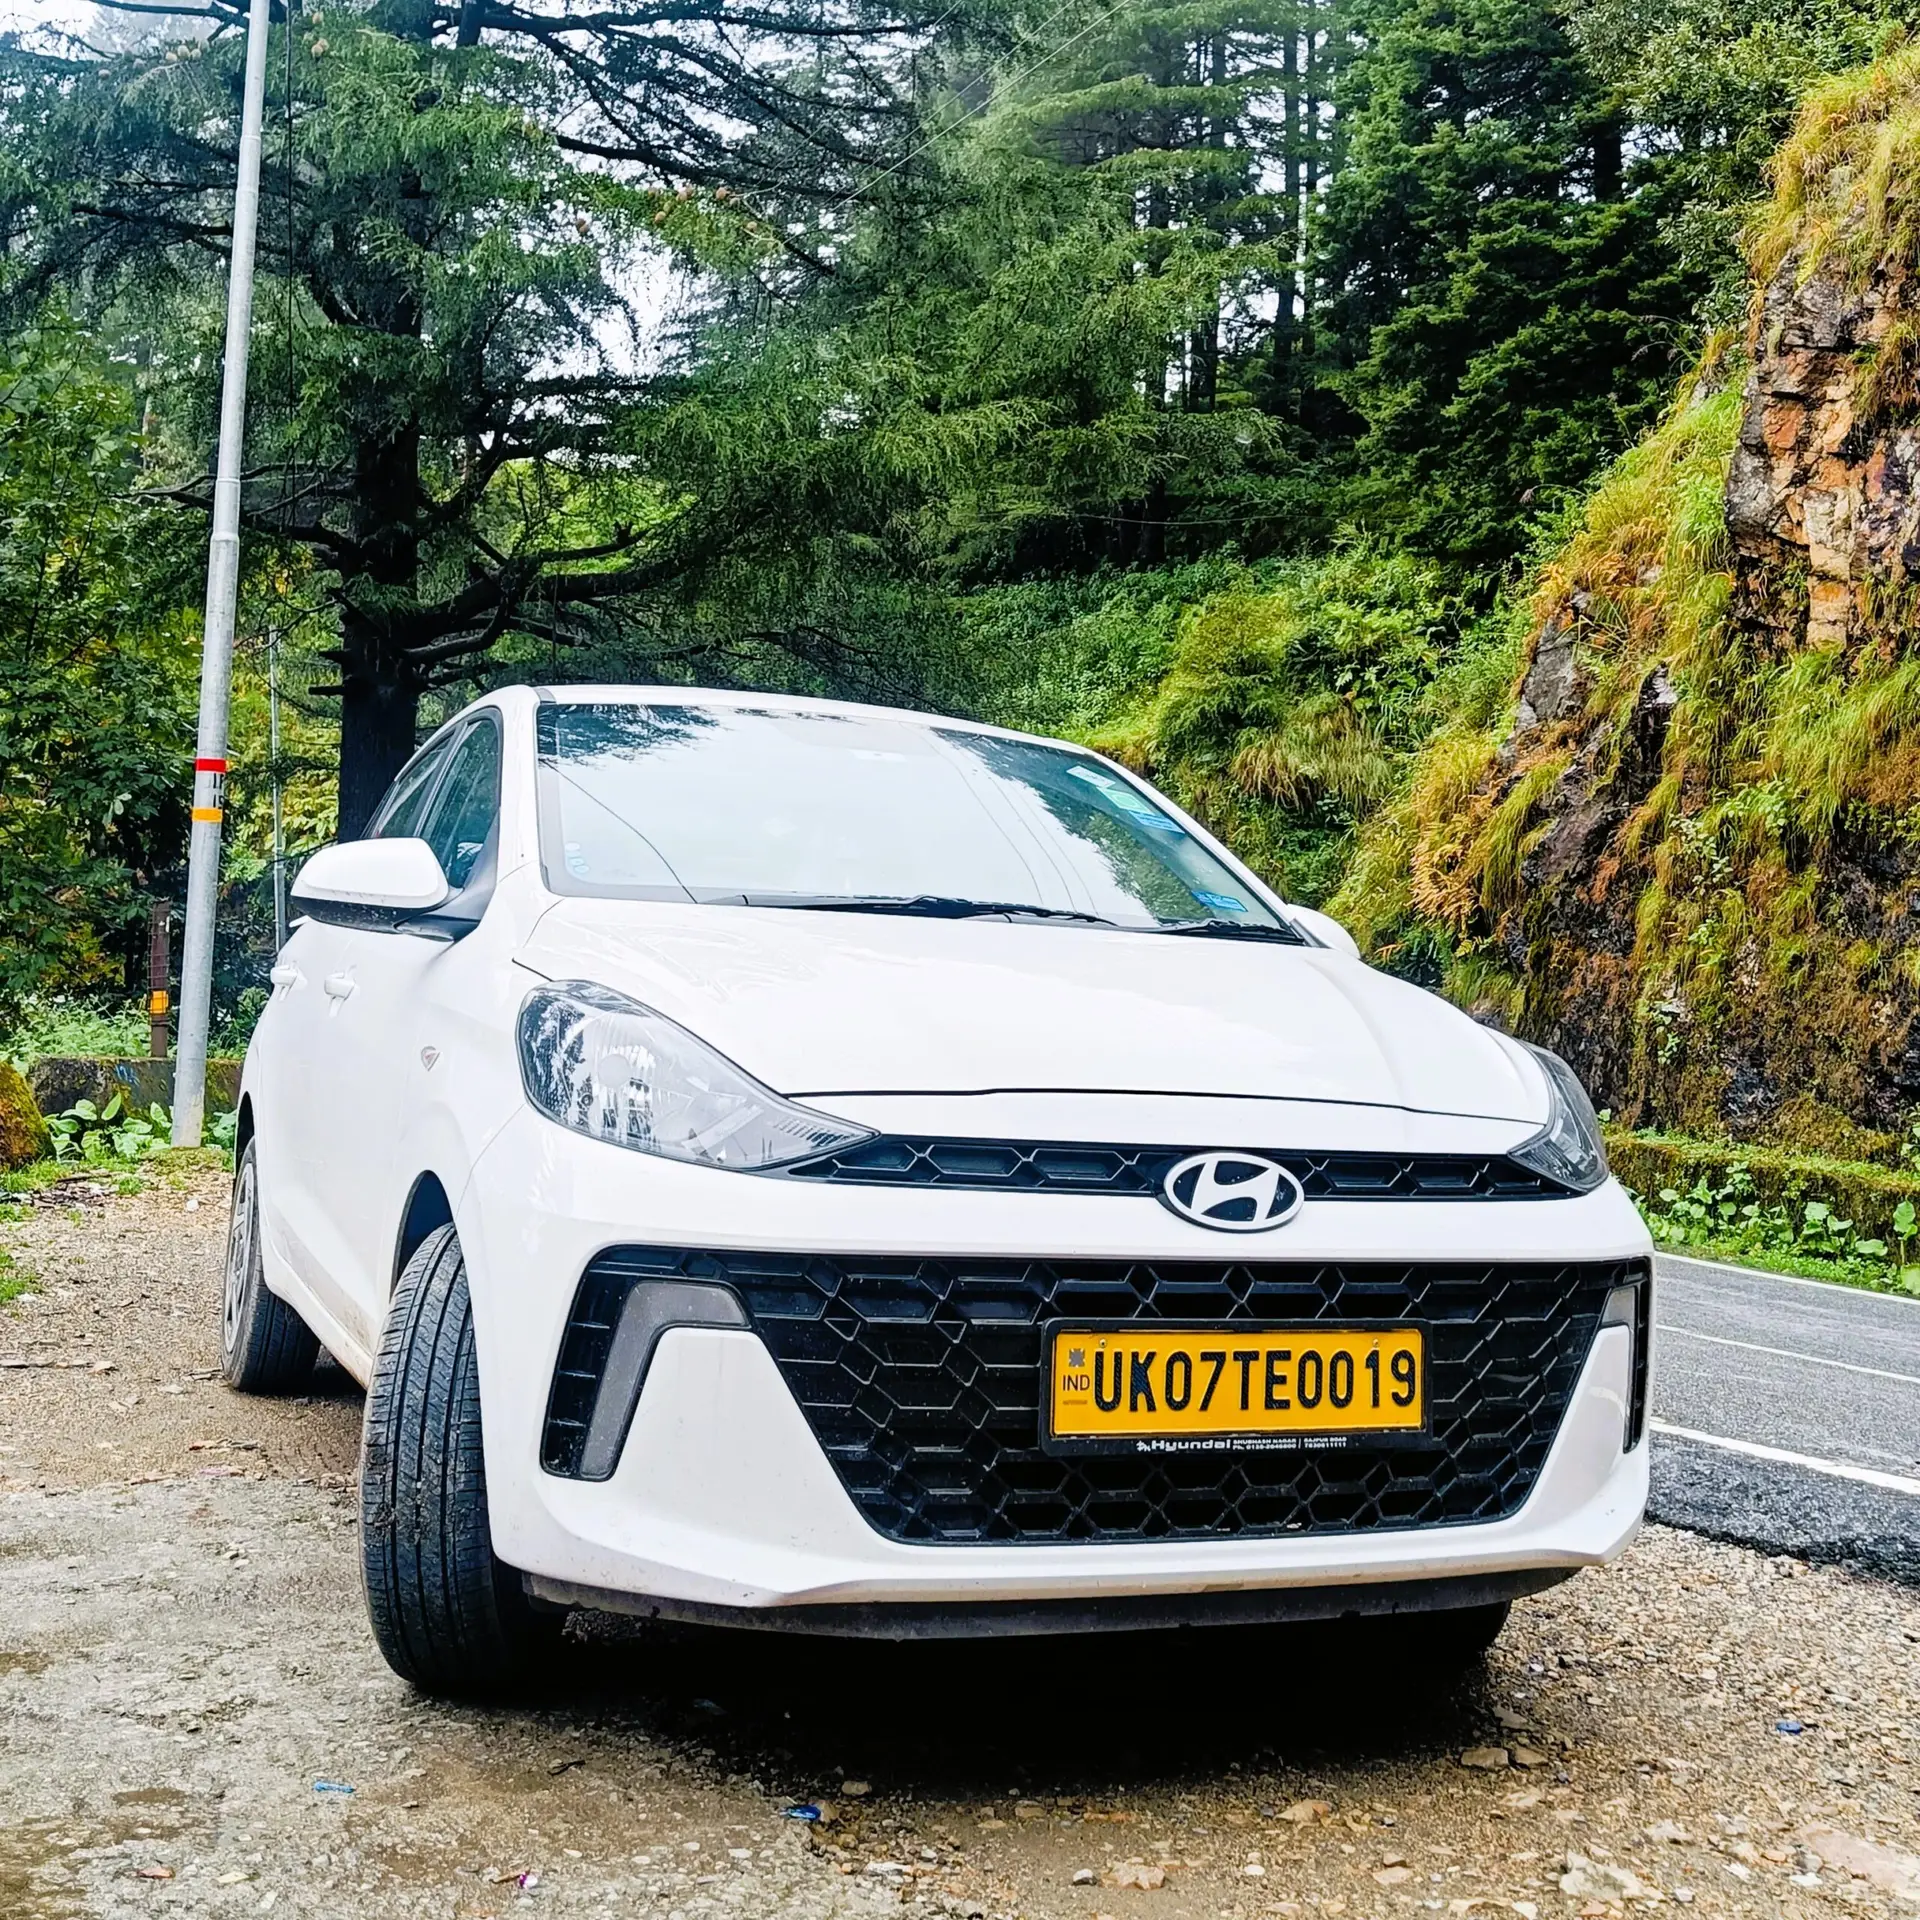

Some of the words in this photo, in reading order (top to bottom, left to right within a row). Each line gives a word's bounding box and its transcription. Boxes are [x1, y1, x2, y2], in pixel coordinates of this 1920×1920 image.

[1062, 1374, 1090, 1391] IND
[1094, 1349, 1416, 1412] UK07TE0019
[1151, 1438, 1231, 1451] Hyundai
